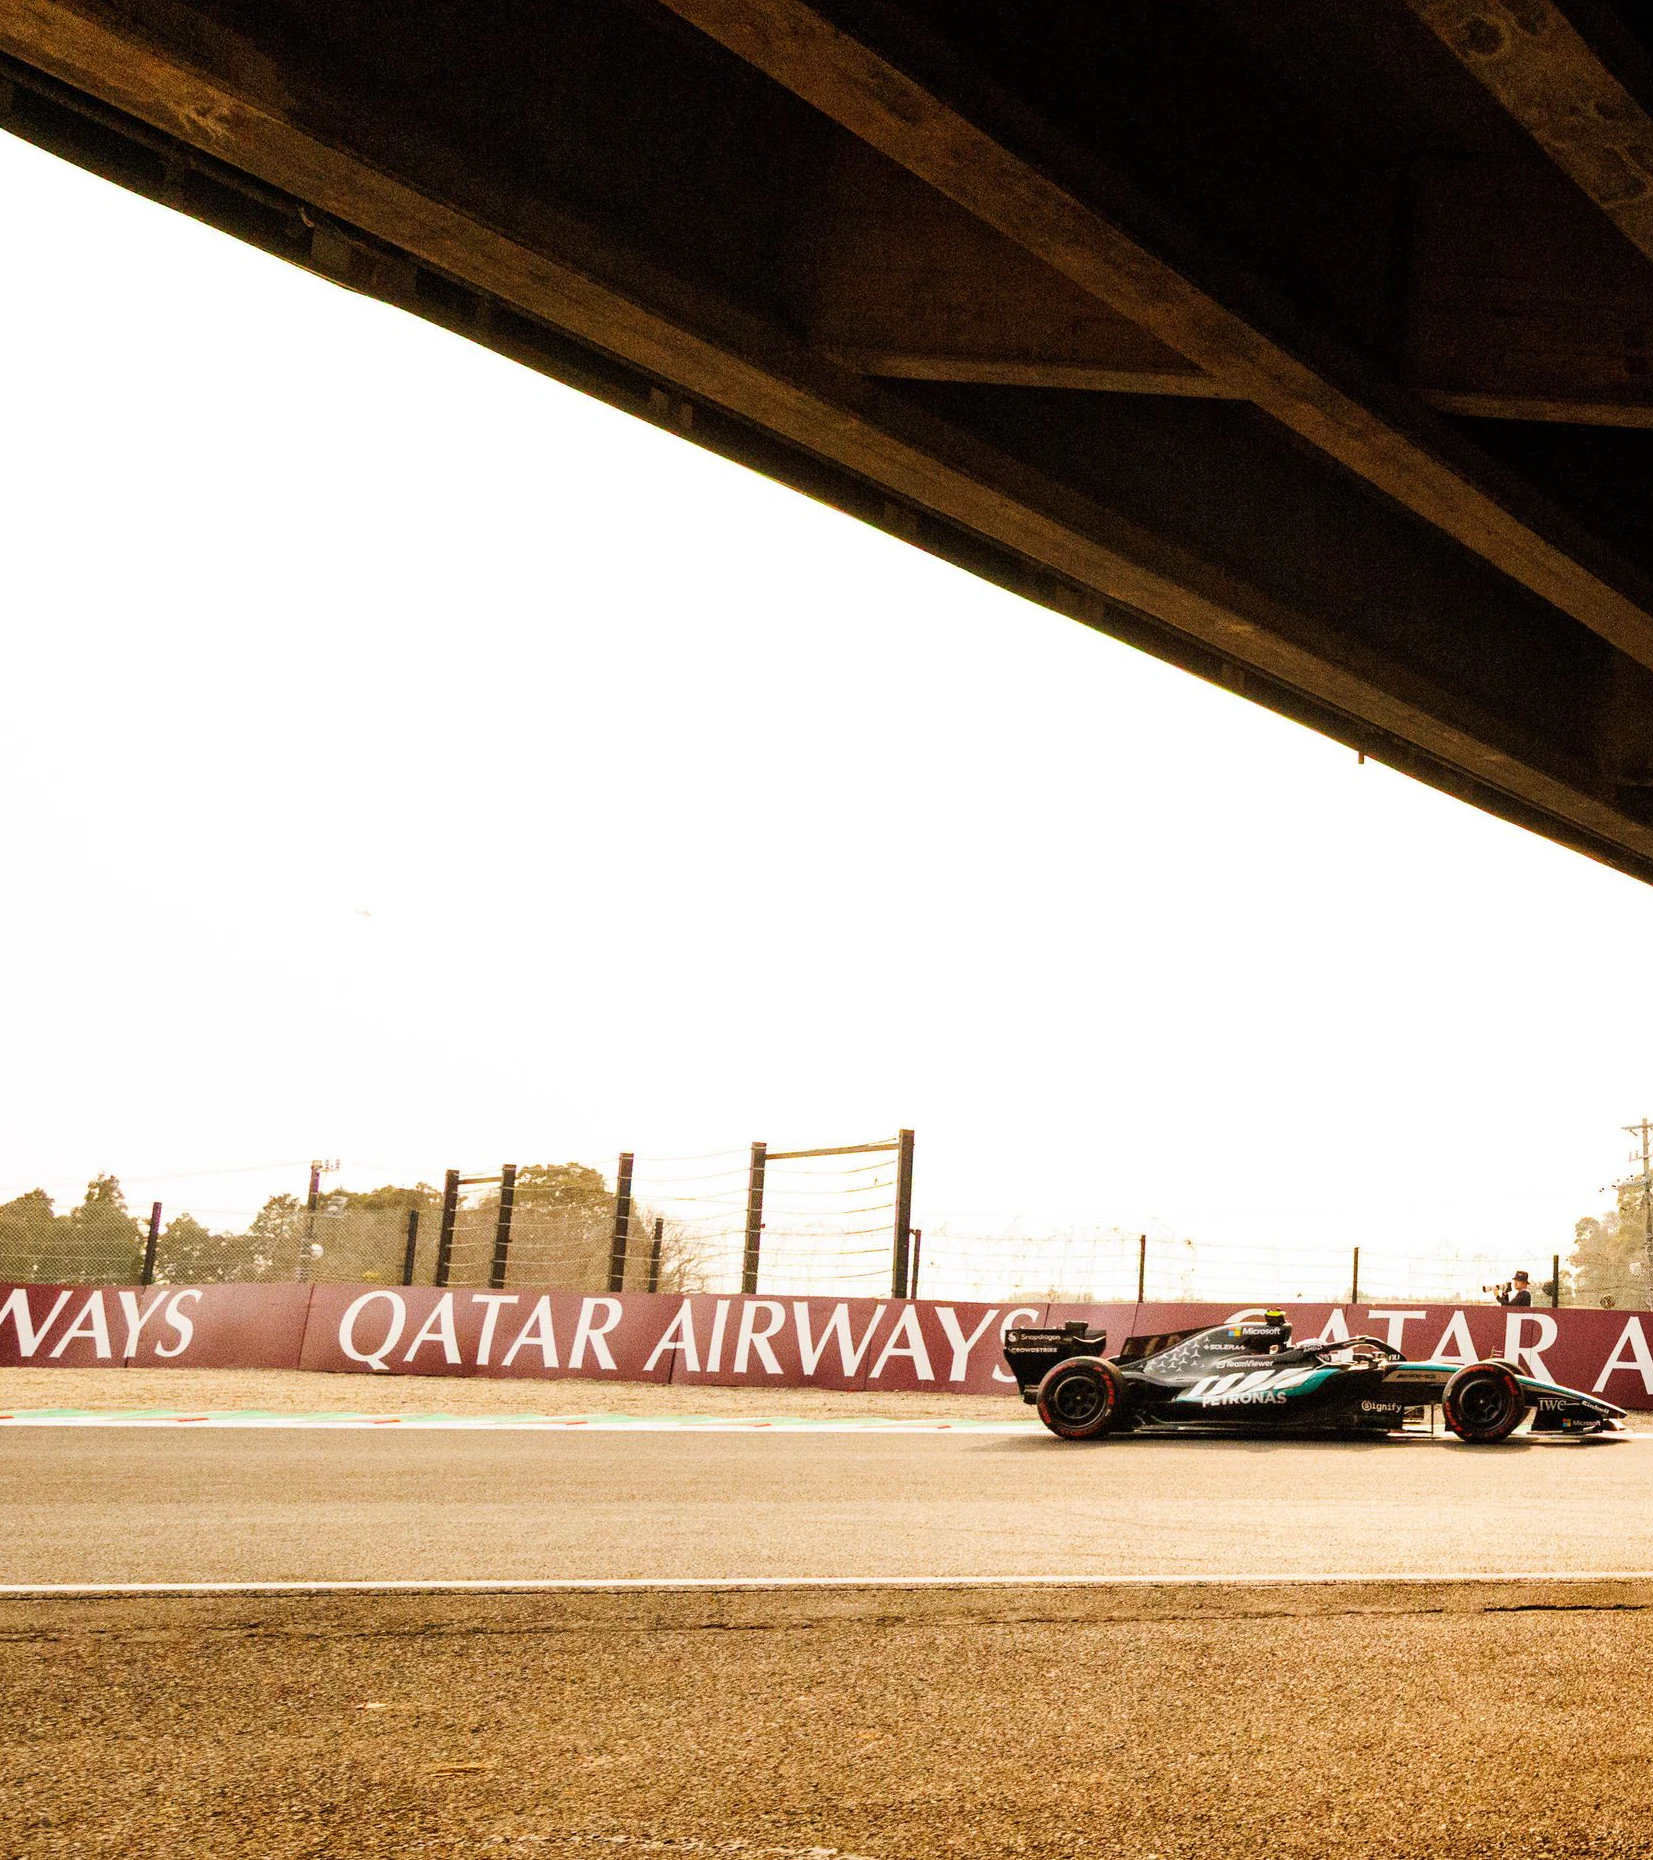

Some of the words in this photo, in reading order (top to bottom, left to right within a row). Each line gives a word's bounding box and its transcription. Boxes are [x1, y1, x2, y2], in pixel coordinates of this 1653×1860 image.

[1242, 1326, 1281, 1335] Microsoft
[338, 1290, 622, 1370] QATAR
[643, 1298, 1039, 1383] AIRWAYS
[1021, 1333, 1061, 1341] Snapdragon
[1223, 1307, 1559, 1384] ATAR
[1224, 1360, 1274, 1368] TeamViewer
[1202, 1391, 1287, 1408] PETRONAS
[1539, 1400, 1567, 1412] IWC
[1572, 1419, 1602, 1427] Microsoft
